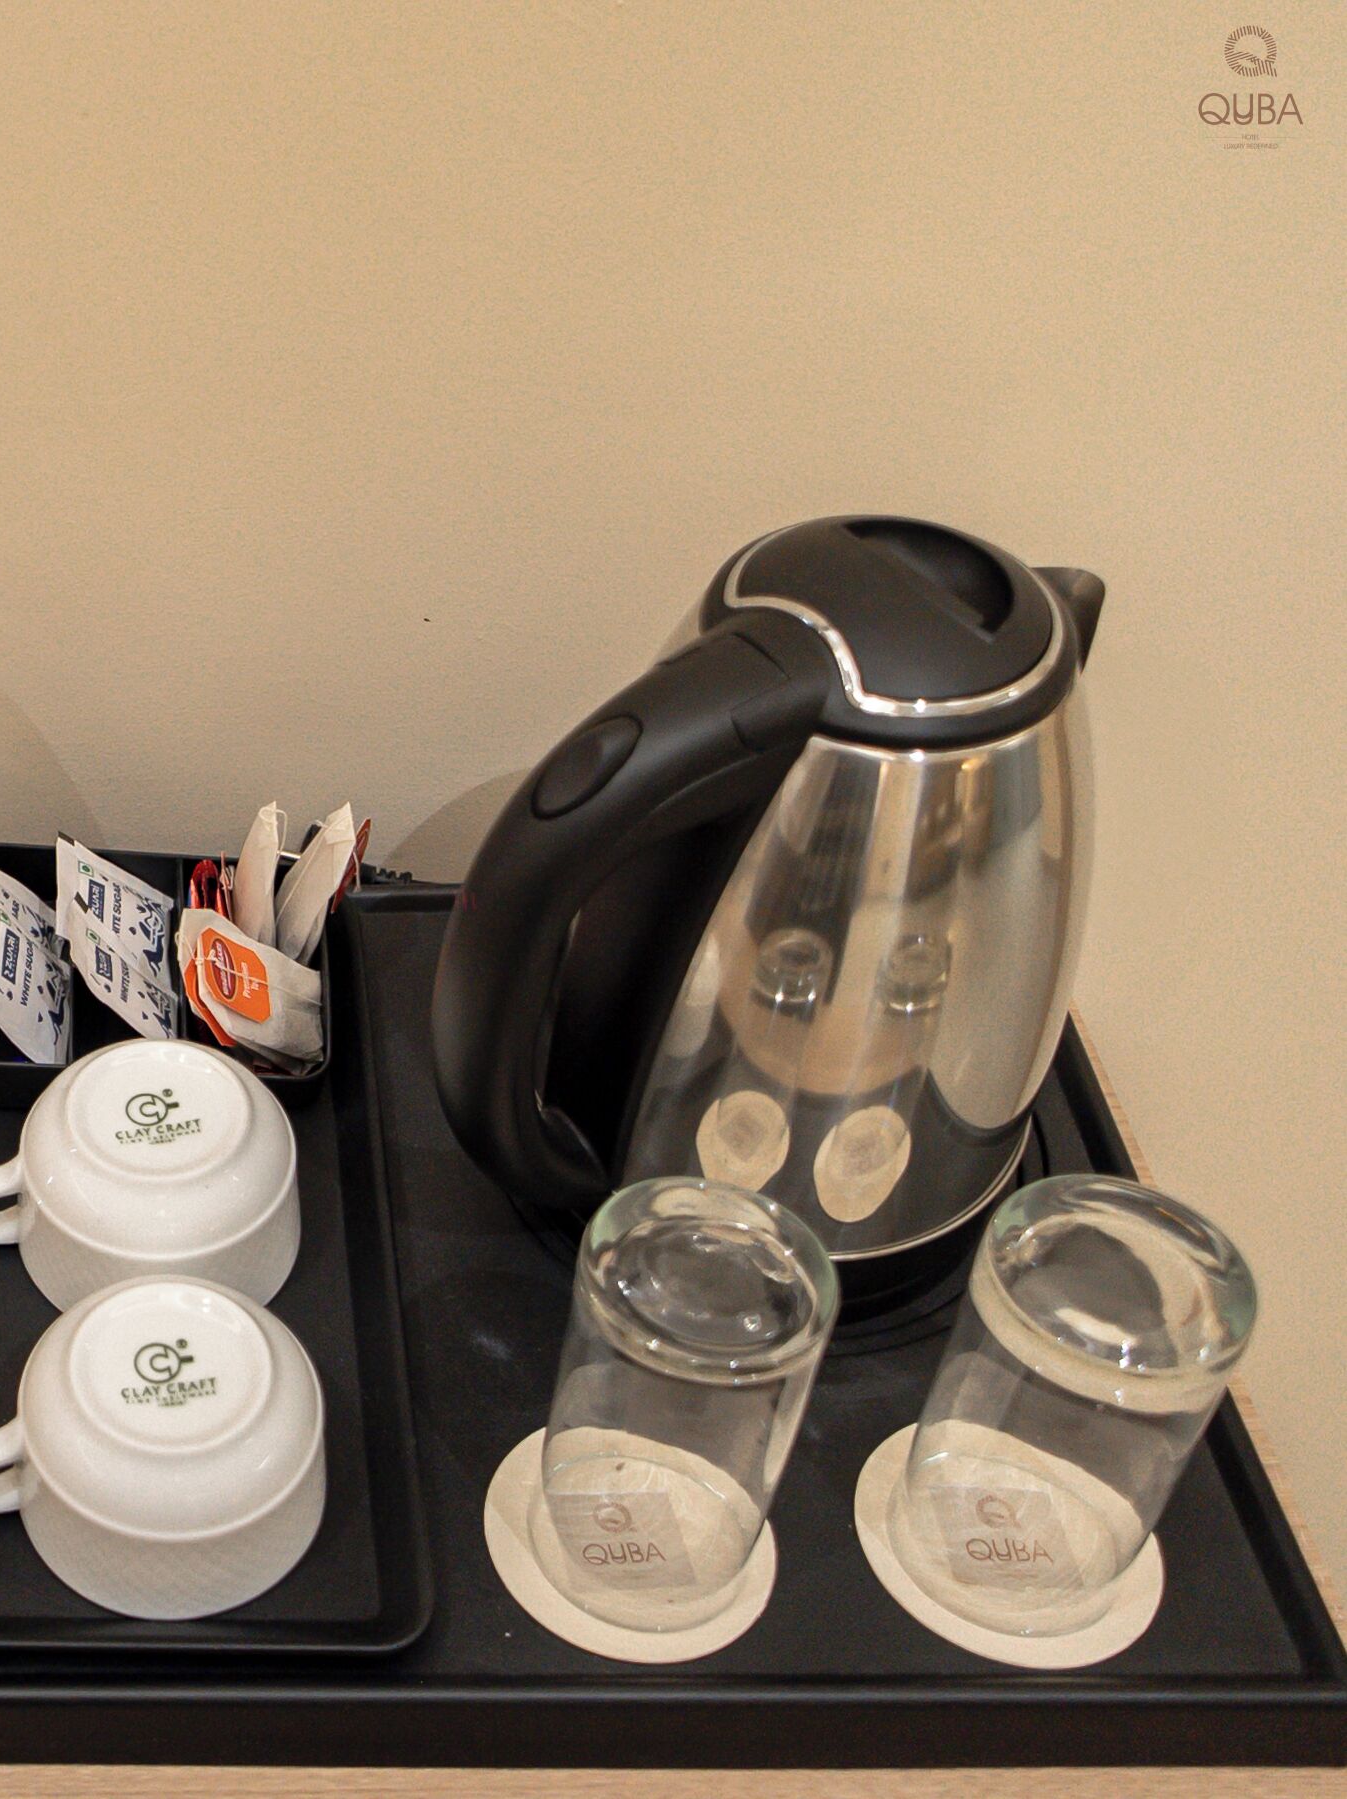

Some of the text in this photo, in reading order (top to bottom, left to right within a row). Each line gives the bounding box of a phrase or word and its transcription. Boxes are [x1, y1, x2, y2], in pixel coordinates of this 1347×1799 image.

[4, 935, 16, 968] ZUARI
[20, 969, 33, 1007] WHITE
[115, 1119, 201, 1140] CLAY CRAFT
[121, 1377, 216, 1399] CLAY CRAFT
[582, 1542, 667, 1566] QUBA
[965, 1538, 1054, 1563] QUBA
